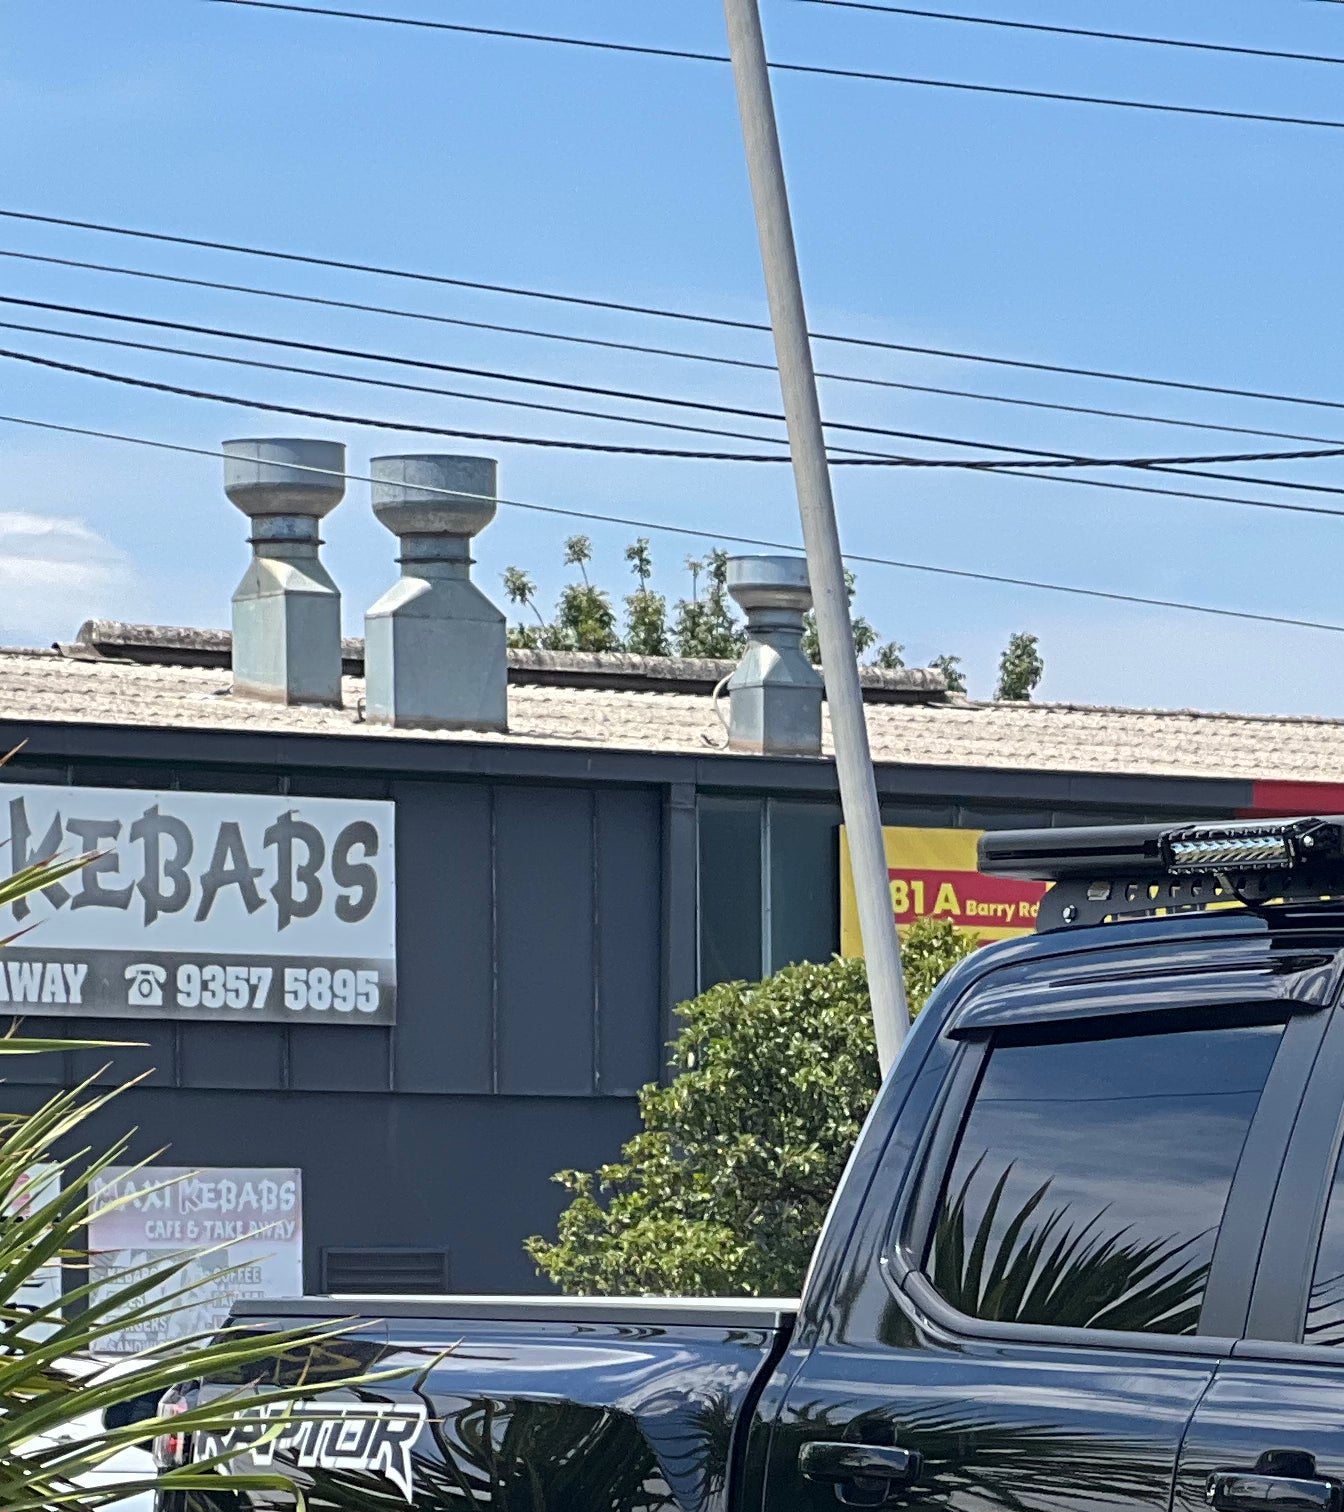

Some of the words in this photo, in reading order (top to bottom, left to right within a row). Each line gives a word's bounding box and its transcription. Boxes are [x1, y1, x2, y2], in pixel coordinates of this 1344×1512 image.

[9, 796, 380, 932] KEBABS
[965, 899, 1015, 922] Barry
[176, 964, 273, 1009] 9357
[284, 968, 380, 1013] 5895
[179, 1178, 296, 1215] KEBABS
[145, 1220, 182, 1239] CAFE
[187, 1221, 199, 1239] &
[203, 1220, 243, 1239] TAKE
